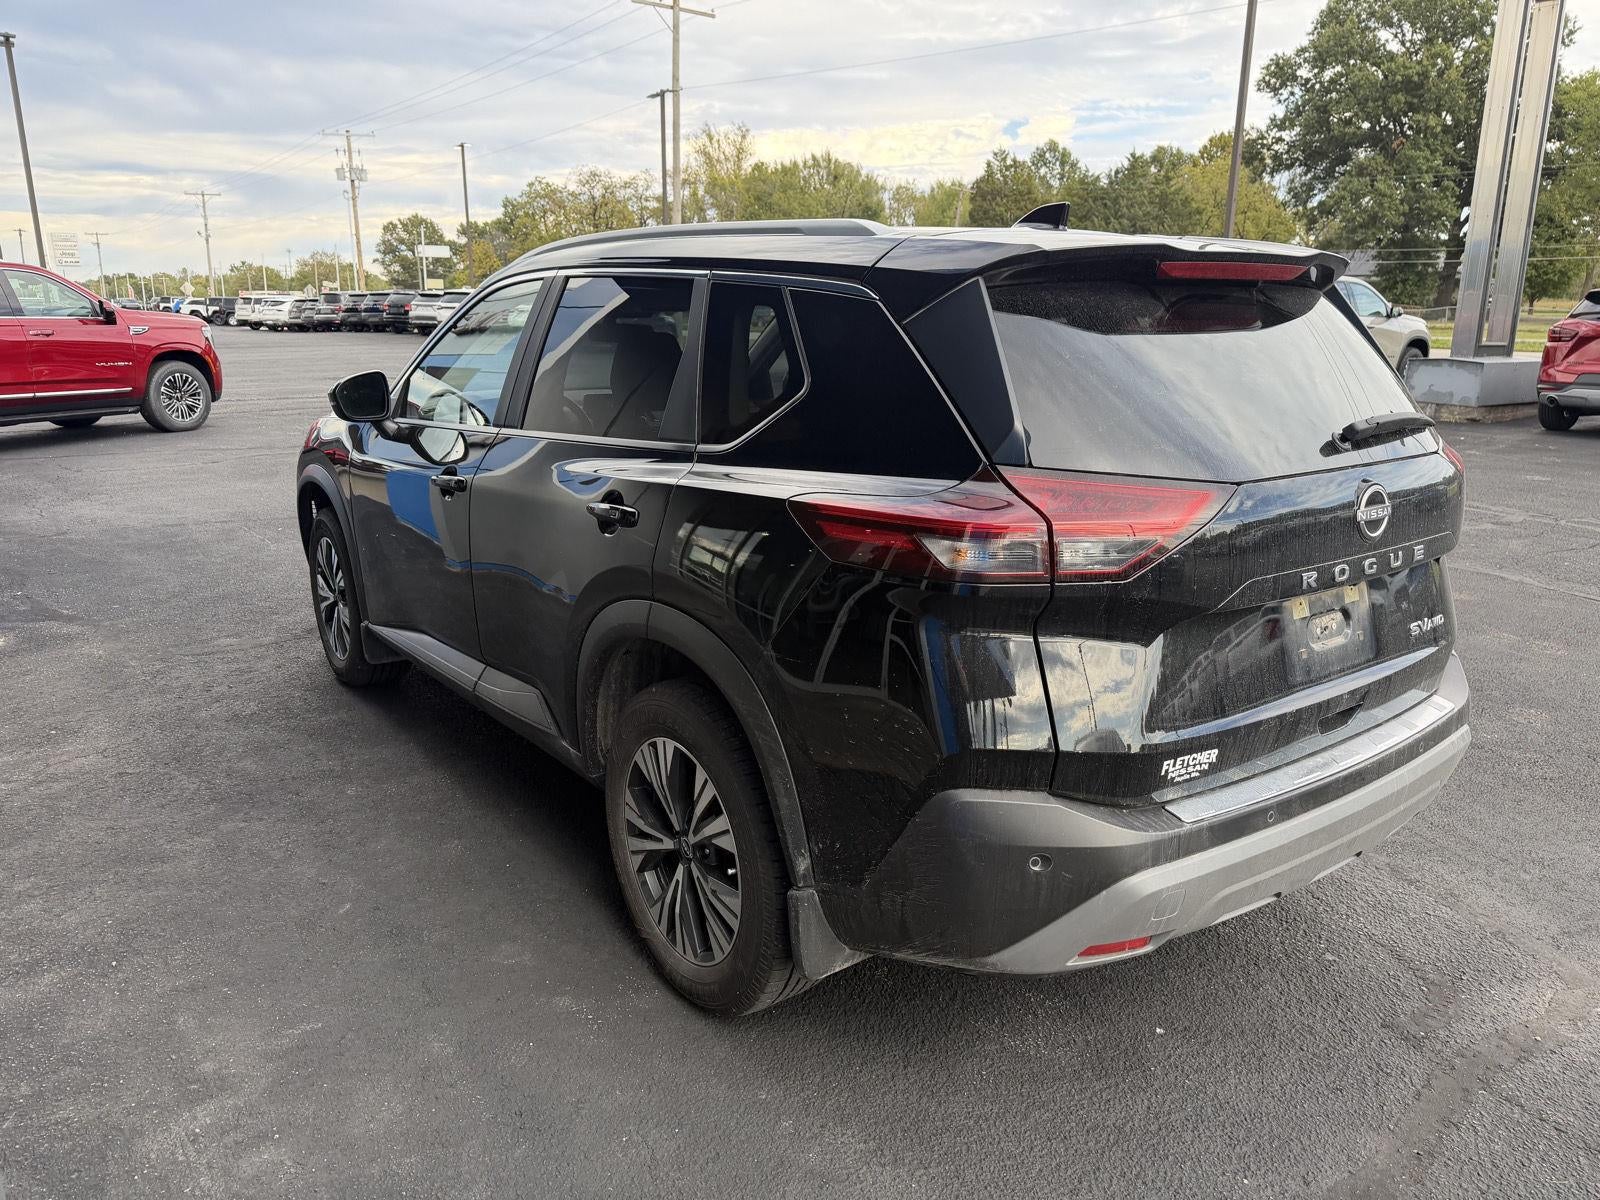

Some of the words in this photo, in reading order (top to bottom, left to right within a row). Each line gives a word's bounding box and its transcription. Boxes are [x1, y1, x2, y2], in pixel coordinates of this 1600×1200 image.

[1358, 504, 1392, 520] NISSAN
[1301, 544, 1425, 590] ROGUE
[1161, 749, 1218, 775] FLETCHER
[1168, 764, 1209, 779] NISSAN
